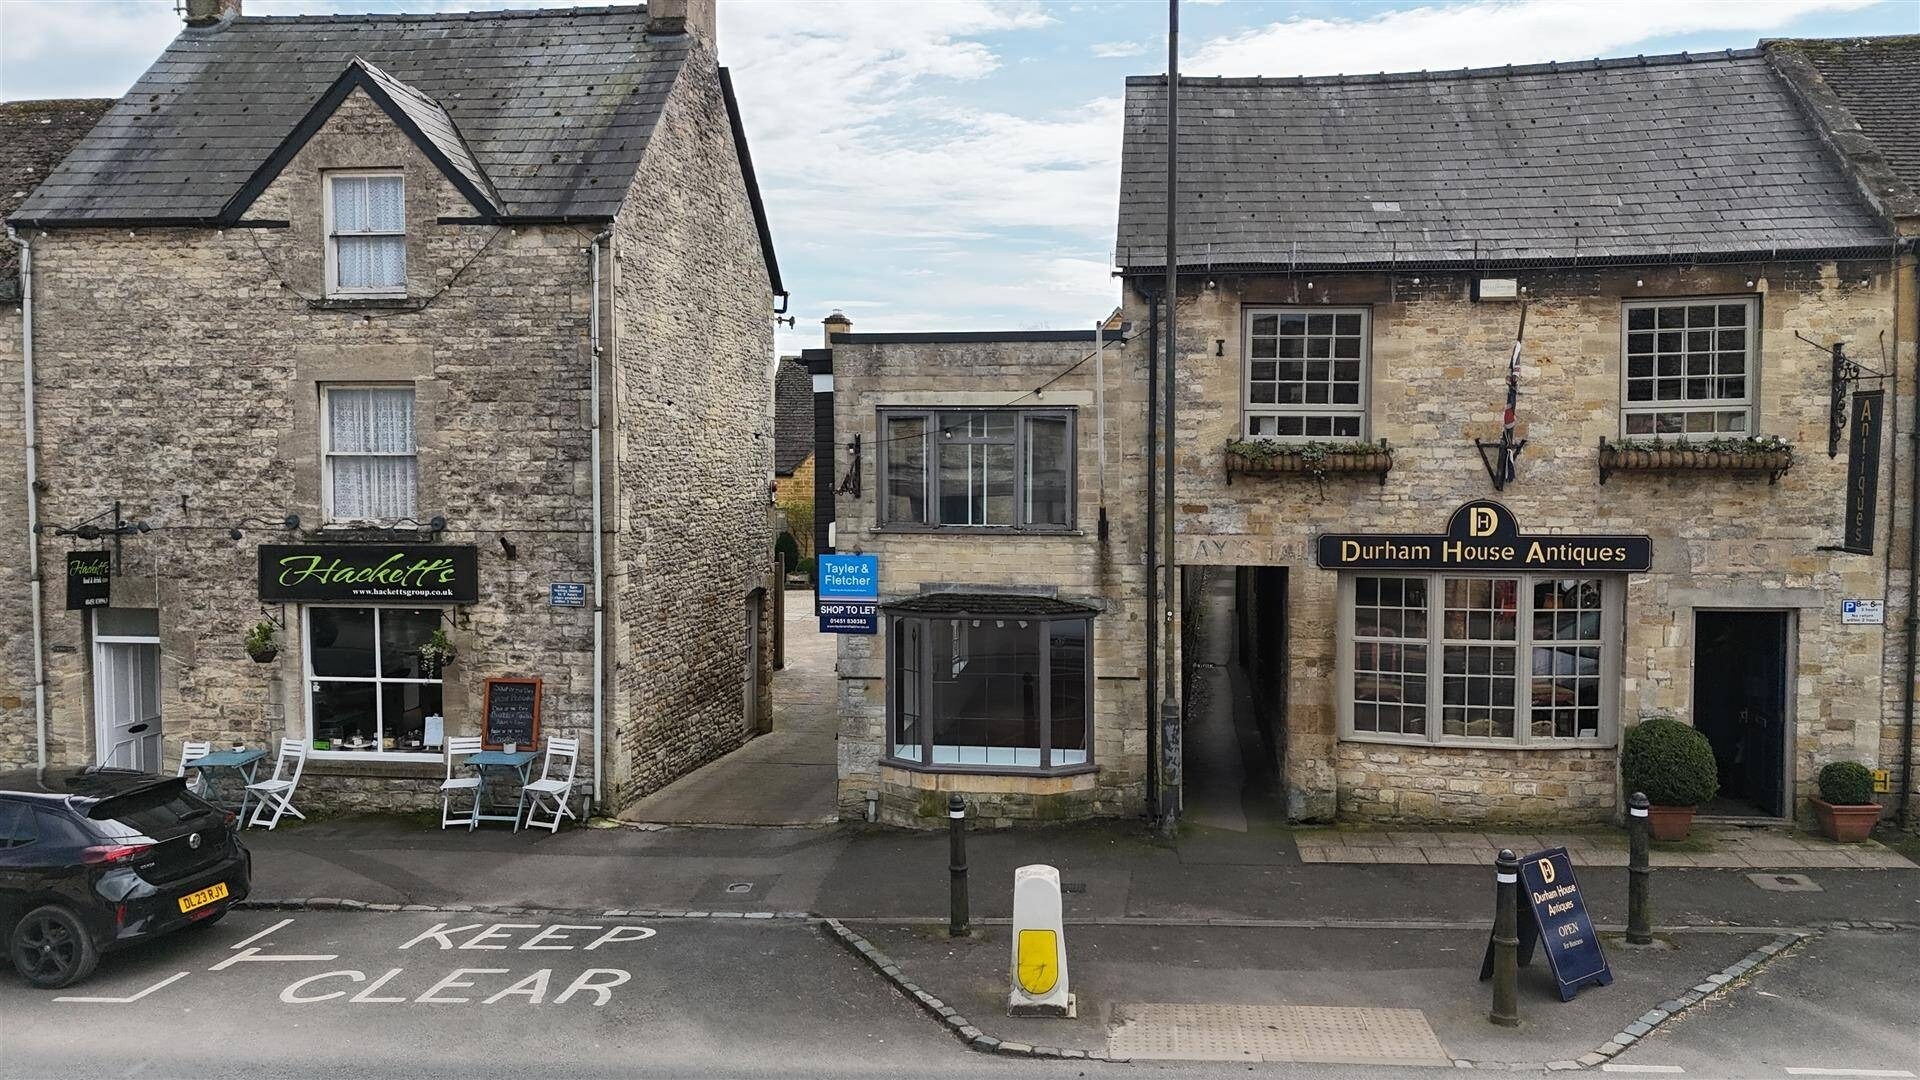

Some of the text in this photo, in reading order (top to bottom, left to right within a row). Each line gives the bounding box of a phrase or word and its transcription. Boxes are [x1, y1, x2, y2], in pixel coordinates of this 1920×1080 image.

[1855, 399, 1872, 542] Antiques
[1341, 540, 1626, 566] Durham House Antiques
[278, 553, 456, 587] Hackett's
[825, 563, 869, 575] Tayler &
[825, 575, 871, 586] Fletcher
[352, 588, 454, 597] www.hackettsgroup.co.uk
[820, 605, 876, 615] SHOP TO LET
[183, 885, 224, 909] DL23 RJY
[1533, 884, 1577, 904] Durham House
[1548, 900, 1574, 917] Antiques
[398, 922, 657, 950] KEEP
[1558, 922, 1580, 937] OPEN
[279, 968, 632, 1006] CLEAR
